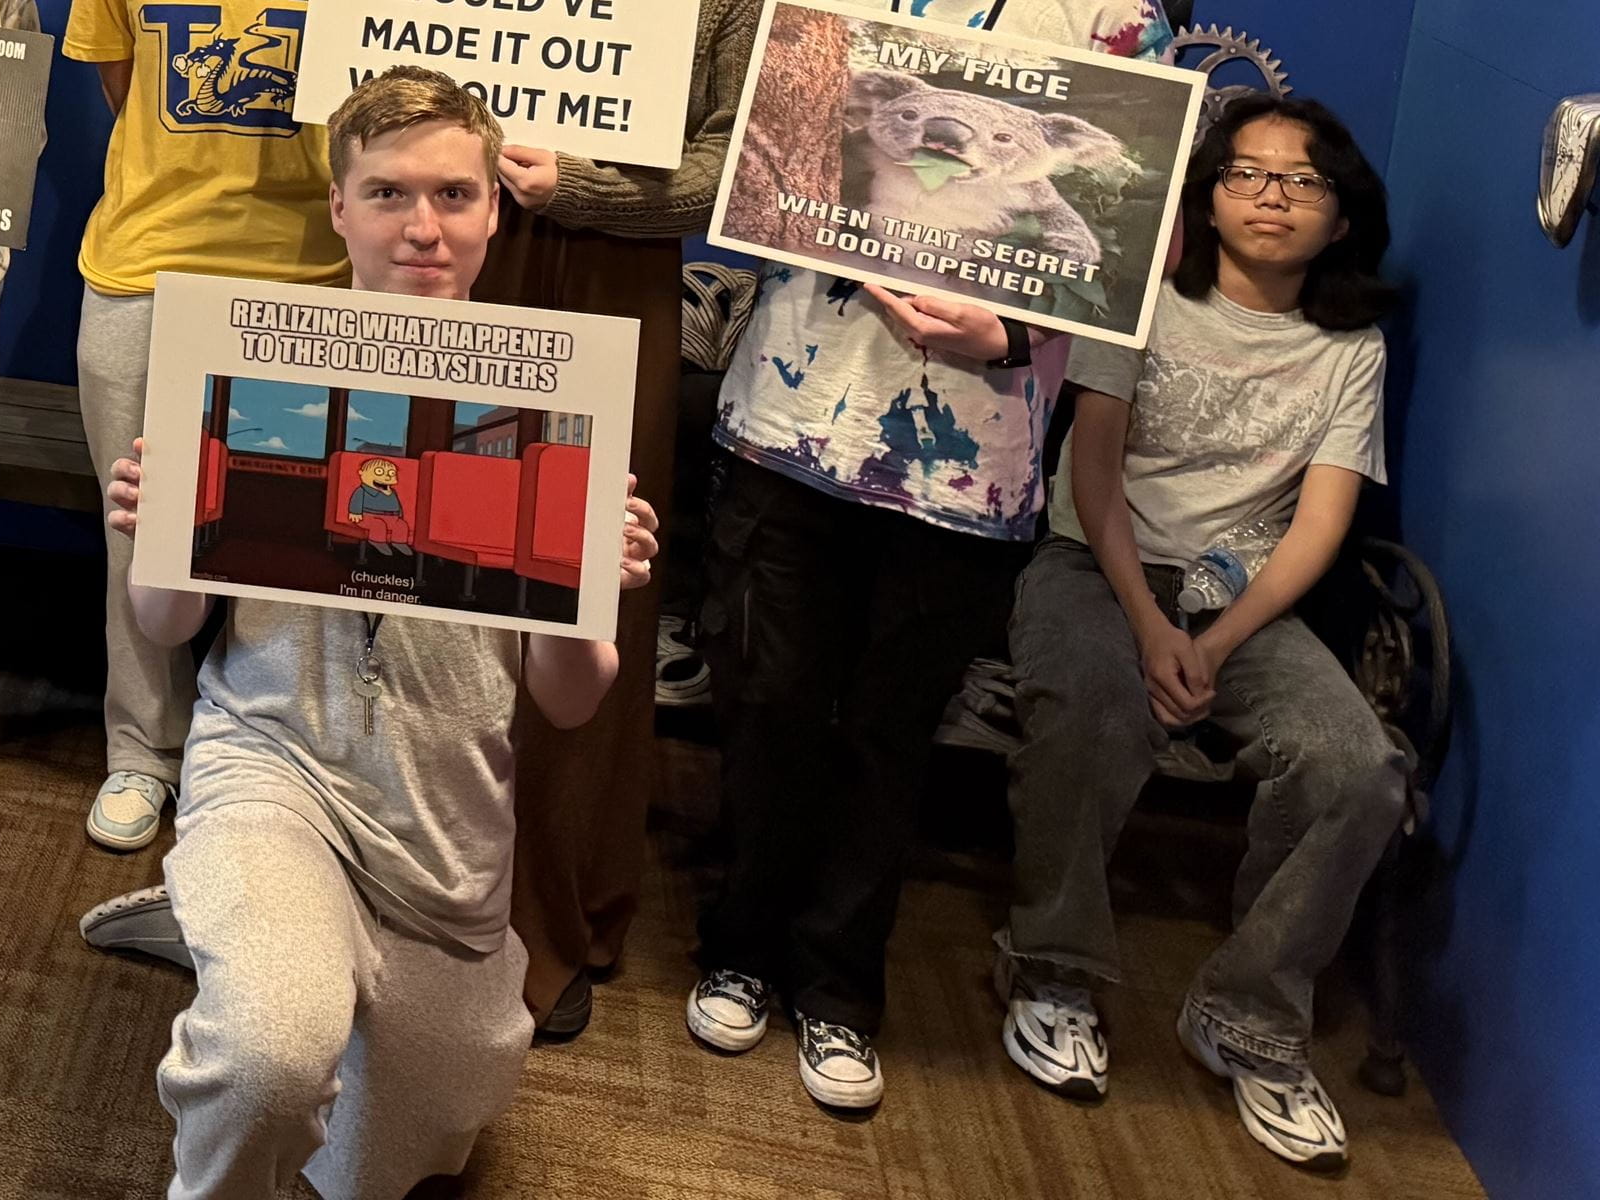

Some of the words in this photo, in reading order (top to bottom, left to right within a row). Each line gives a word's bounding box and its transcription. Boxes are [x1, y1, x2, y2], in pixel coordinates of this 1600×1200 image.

[361, 17, 478, 61] MADE
[492, 31, 530, 66] IT
[541, 36, 632, 76] OUT
[878, 41, 952, 75] MY
[963, 57, 1071, 101] FACE
[349, 67, 546, 121] WOUT
[557, 92, 632, 132] ME!
[776, 192, 872, 230] WHEN
[883, 216, 961, 251] THAT
[972, 238, 1101, 283] SECRET
[815, 227, 902, 265] DOOR
[914, 251, 1045, 297] OPENED
[230, 299, 357, 339] REALIZING
[361, 311, 438, 347] WHAT
[439, 319, 573, 361] HAPPENED
[242, 331, 275, 362] TO
[279, 335, 327, 369] THE
[329, 340, 379, 373] OLD
[381, 345, 557, 393] BABYSITTERS
[340, 583, 358, 597] I'm
[361, 586, 372, 599] in
[376, 589, 422, 606] danger.
[351, 570, 415, 590] (chuckles)
